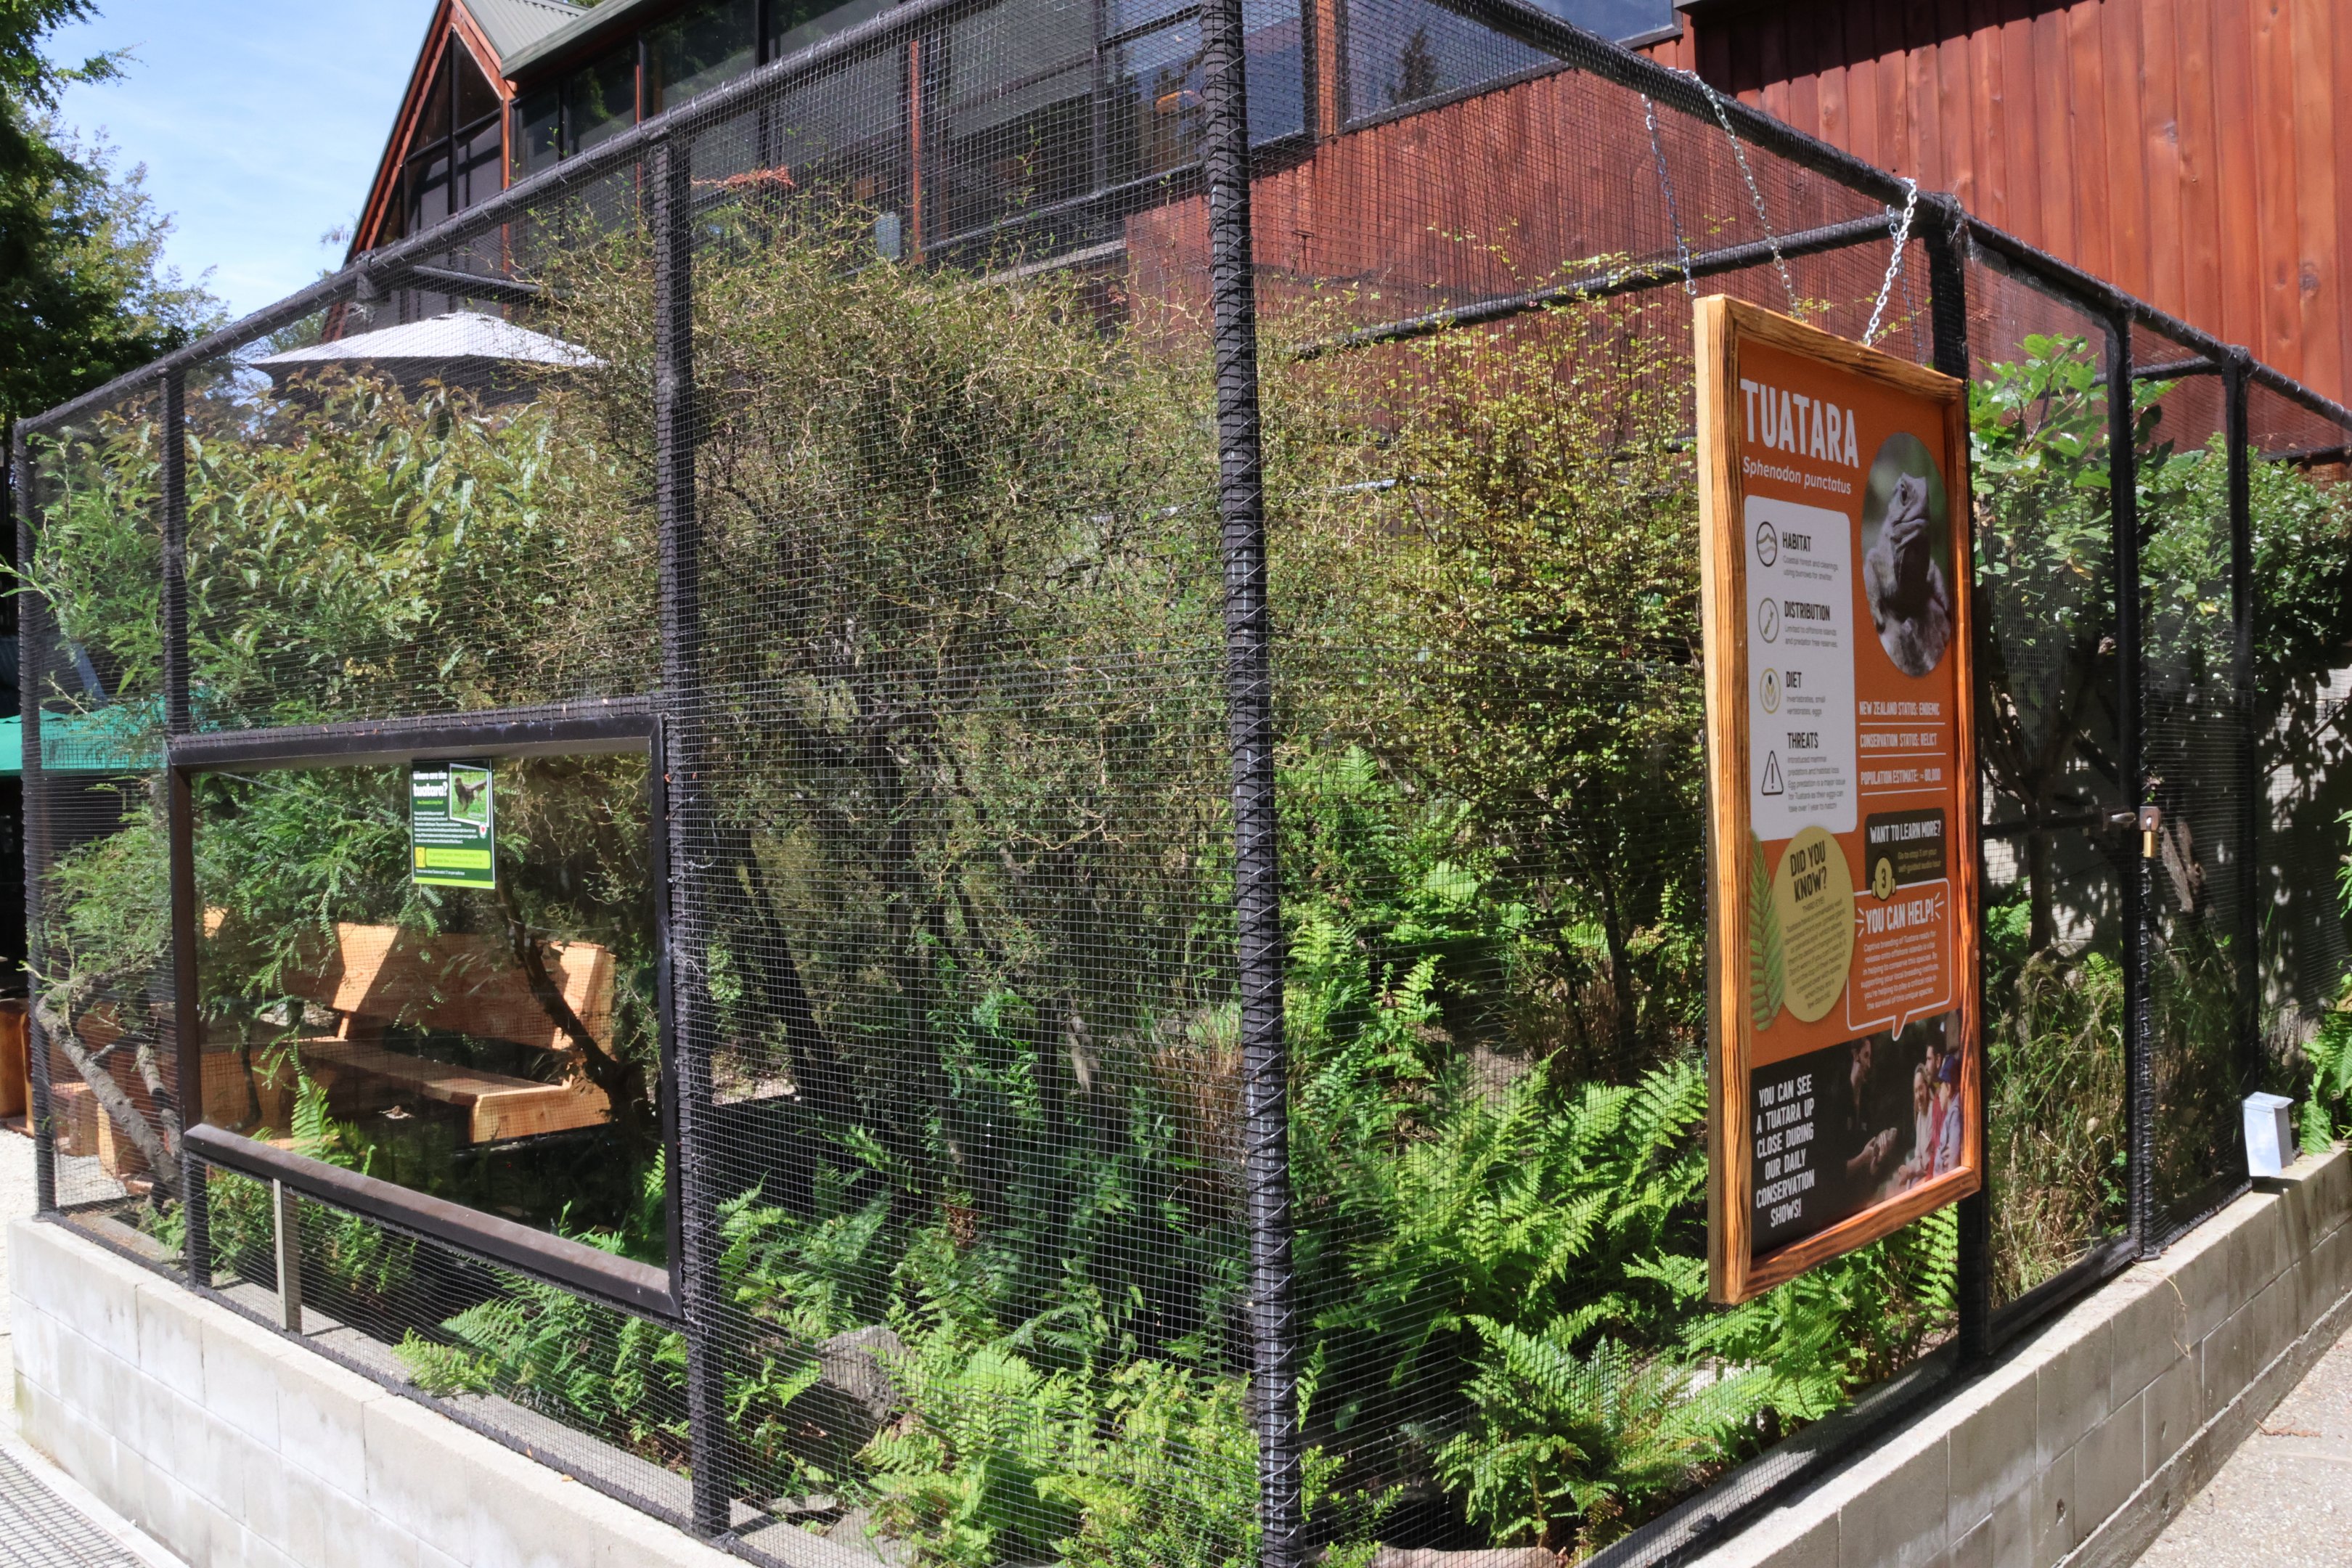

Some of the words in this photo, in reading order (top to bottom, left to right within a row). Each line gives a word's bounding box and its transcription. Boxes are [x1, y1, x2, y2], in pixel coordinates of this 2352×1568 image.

[1741, 378, 1858, 468] TUATARA
[1743, 456, 1801, 484] Sphenodon
[1804, 473, 1851, 494] punctatus
[1783, 532, 1811, 552] HABITAT
[1784, 601, 1830, 621] DISTRIBUTION
[1786, 671, 1802, 687] DIET
[1859, 701, 1872, 715] NEW
[1874, 701, 1897, 715] ZEALAND
[1898, 702, 1918, 716] STATUS:
[1919, 702, 1940, 716] ENDEMIC
[1787, 732, 1818, 748] THREATS
[1860, 733, 1898, 748] CONSERVATION
[1899, 733, 1919, 747] STATUS:
[1920, 732, 1937, 746] RELICT
[413, 781, 448, 796] tuatara?
[1861, 770, 1892, 785] POPULATION
[1870, 825, 1889, 844] WANT
[1891, 824, 1899, 841] TO
[1900, 821, 1920, 841] LEARN
[1921, 819, 1941, 838] MORE?
[1790, 849, 1805, 877] DID
[1808, 841, 1826, 869] YOU
[1794, 866, 1827, 903] KNOW?
[1866, 908, 1884, 934] YOU
[1887, 904, 1906, 931] CAN
[1907, 898, 1935, 926] HELP!
[1759, 1086, 1774, 1108] YOU
[1778, 1079, 1794, 1103] CAN
[1797, 1074, 1812, 1097] SEE
[1756, 1115, 1763, 1134] A
[1765, 1102, 1802, 1130] TUATARA
[1804, 1098, 1814, 1118] UP
[1757, 1133, 1782, 1159] CLOSE
[1786, 1122, 1814, 1146] DURING
[1765, 1159, 1781, 1180] OUR
[1784, 1148, 1806, 1173] DAILY
[1756, 1169, 1815, 1209] CONSERVATION
[1771, 1197, 1801, 1228] SHOWS!
